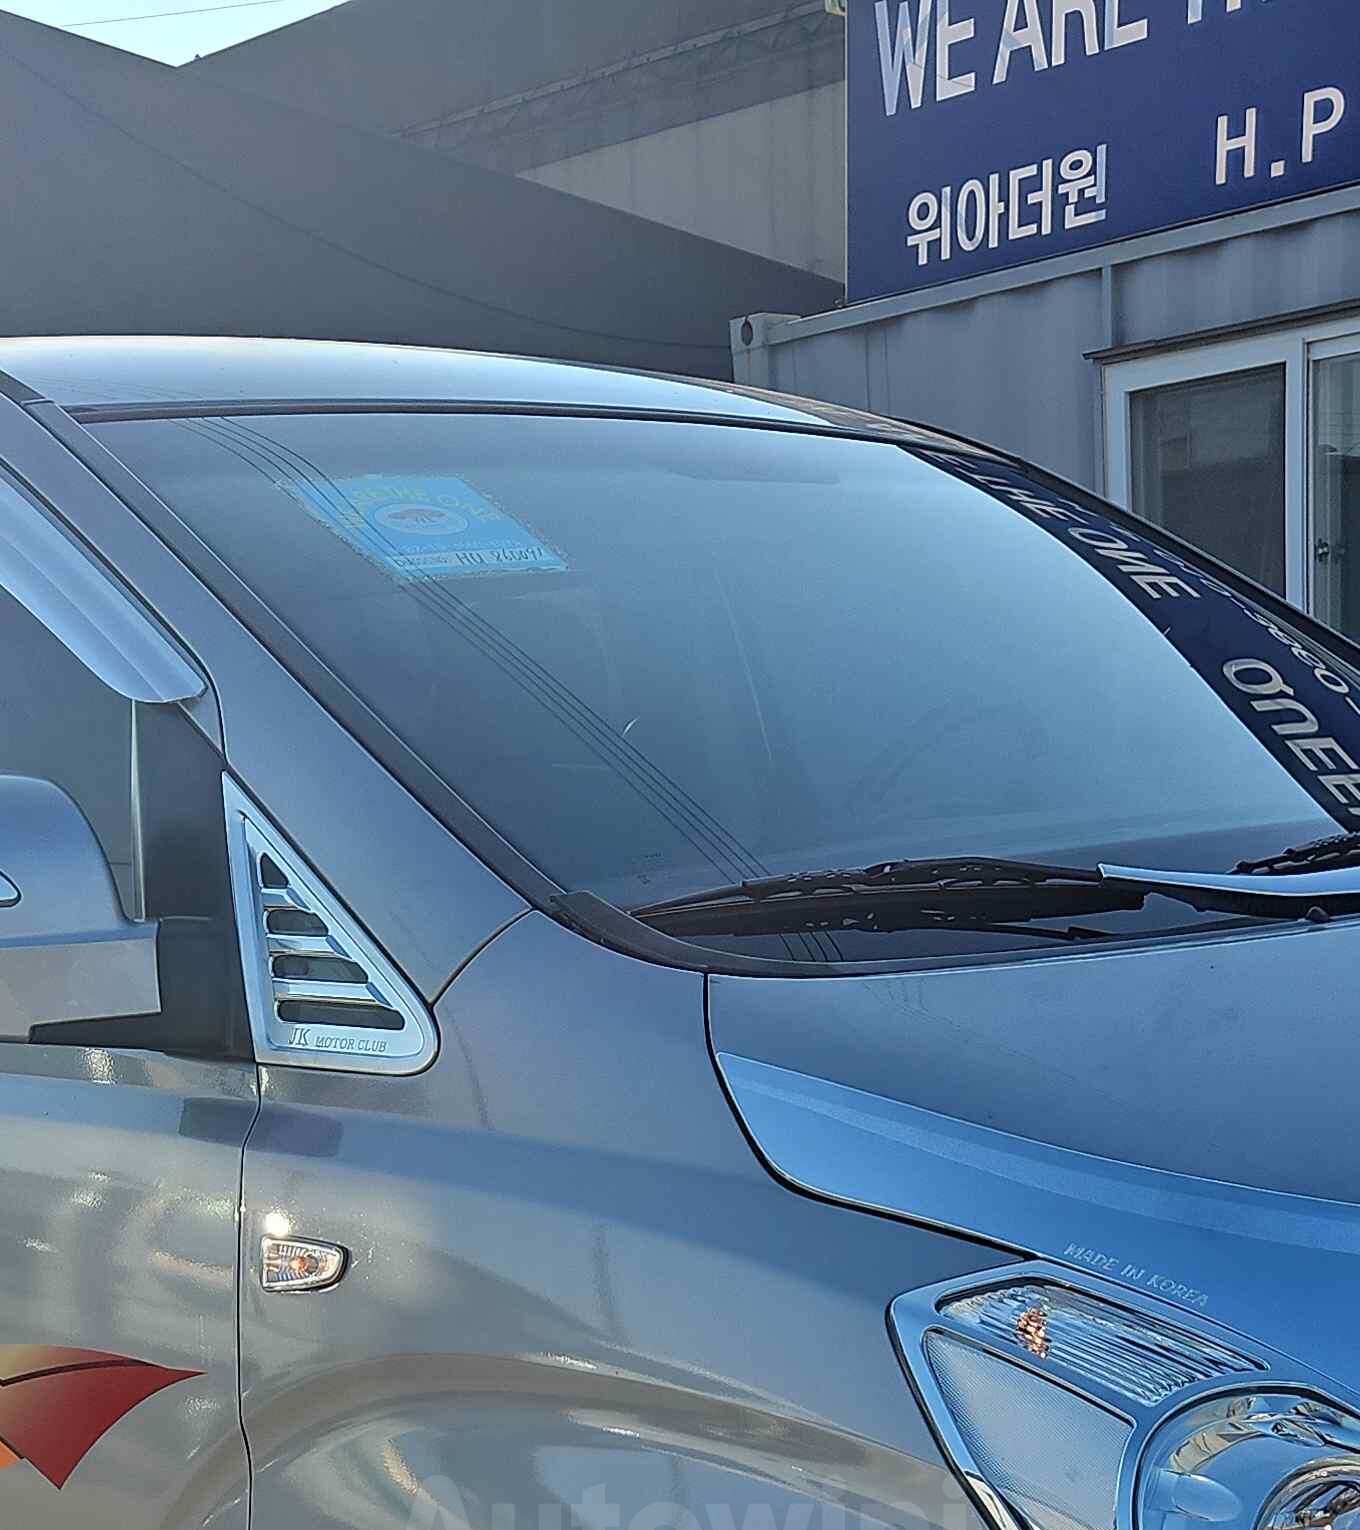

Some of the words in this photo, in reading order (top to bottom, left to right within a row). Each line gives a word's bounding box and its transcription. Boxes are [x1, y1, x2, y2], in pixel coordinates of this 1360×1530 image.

[875, 0, 975, 116] WE
[905, 143, 1109, 266] 위아더원
[315, 1036, 355, 1050] MOTOR
[357, 1039, 388, 1053] CLUB
[1064, 1242, 1120, 1271] MADE
[1120, 1264, 1145, 1281] IN
[1146, 1274, 1209, 1307] KOREA
